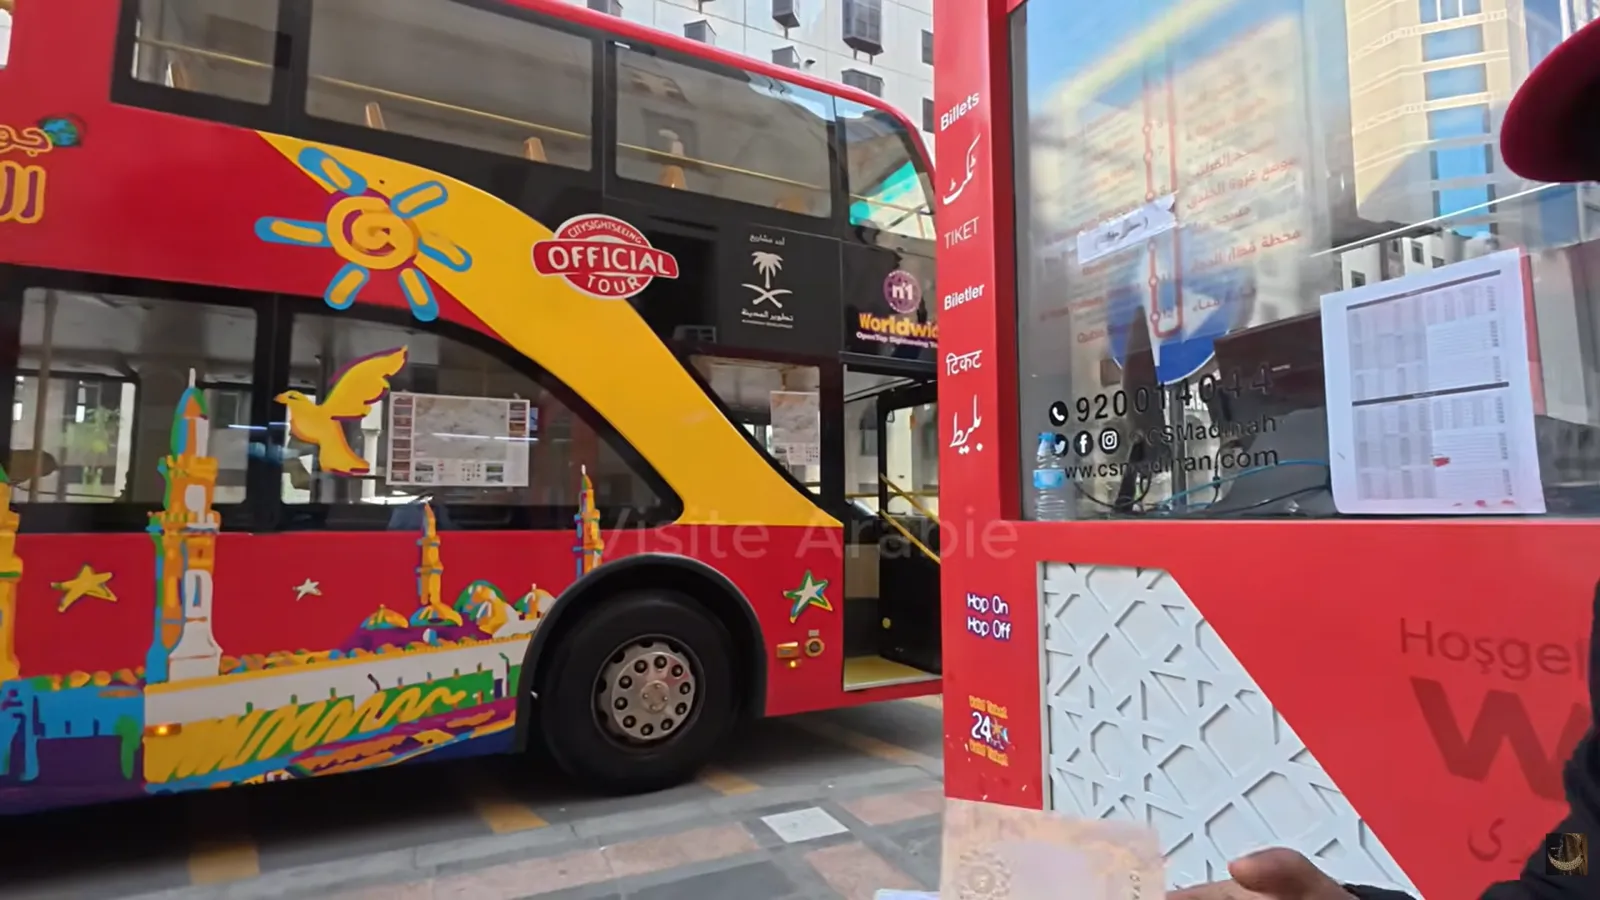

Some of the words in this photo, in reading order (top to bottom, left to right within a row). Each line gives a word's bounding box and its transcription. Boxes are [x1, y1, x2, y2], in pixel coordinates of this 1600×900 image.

[940, 92, 980, 131] Billets
[567, 219, 641, 244] CITYSIGHTSEEING
[943, 216, 980, 249] TIKET
[547, 246, 671, 275] OFFICIAL
[587, 274, 641, 294] TOUR
[943, 284, 985, 310] Biletler
[945, 350, 983, 376] टिकट
[966, 593, 989, 614] Hop
[991, 595, 1008, 615] On
[966, 616, 989, 638] Hop
[991, 619, 1012, 640] Off
[971, 711, 992, 743] 24
